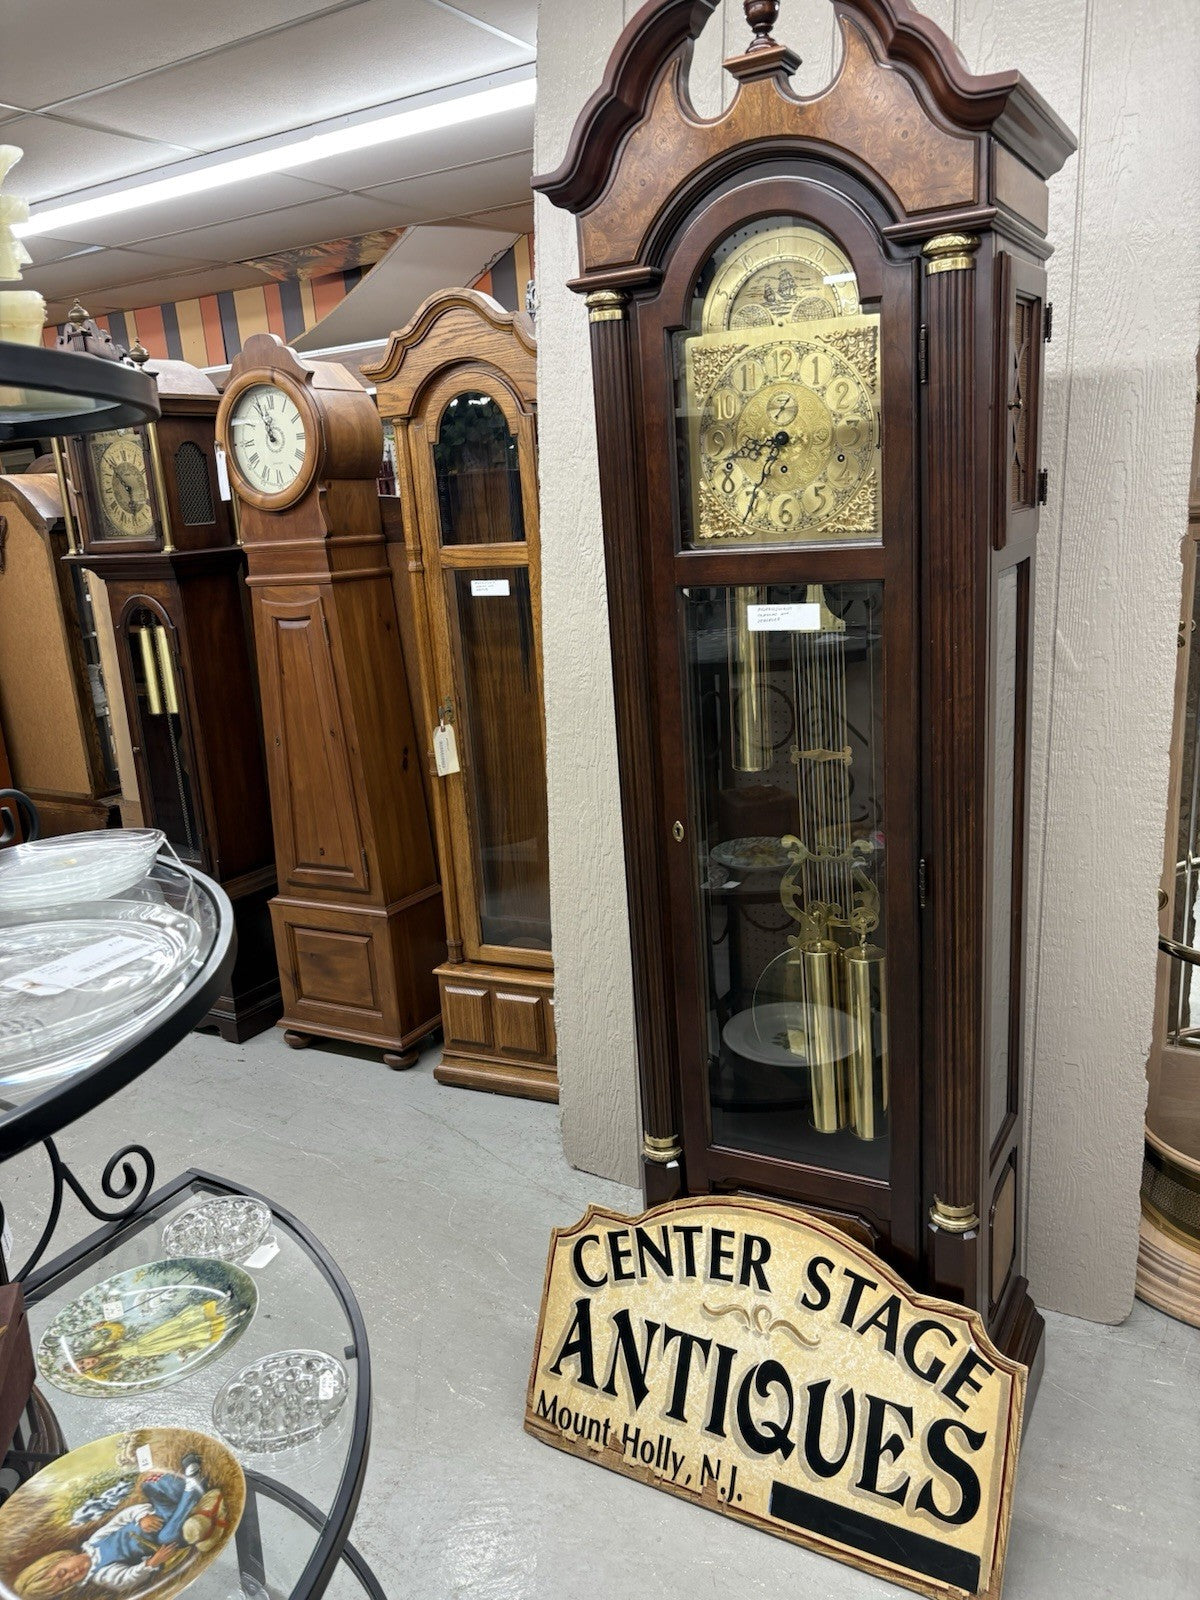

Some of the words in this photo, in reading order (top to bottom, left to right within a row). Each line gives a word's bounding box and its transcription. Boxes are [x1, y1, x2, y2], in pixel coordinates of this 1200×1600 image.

[740, 363, 757, 392] 11
[771, 350, 793, 379] 12
[811, 356, 820, 385] 1
[716, 393, 736, 421] 10
[834, 381, 850, 410] 2
[712, 431, 726, 457] 9
[845, 420, 861, 447] 3
[720, 465, 736, 494] 8
[778, 498, 793, 525] 6
[813, 485, 827, 514] 5
[573, 1225, 773, 1293] CENTER
[800, 1257, 996, 1412] STAGE
[549, 1298, 988, 1526] ANTIQUES
[536, 1389, 611, 1447] Mount
[622, 1422, 693, 1486] Holly,
[700, 1453, 744, 1503] N.J.
